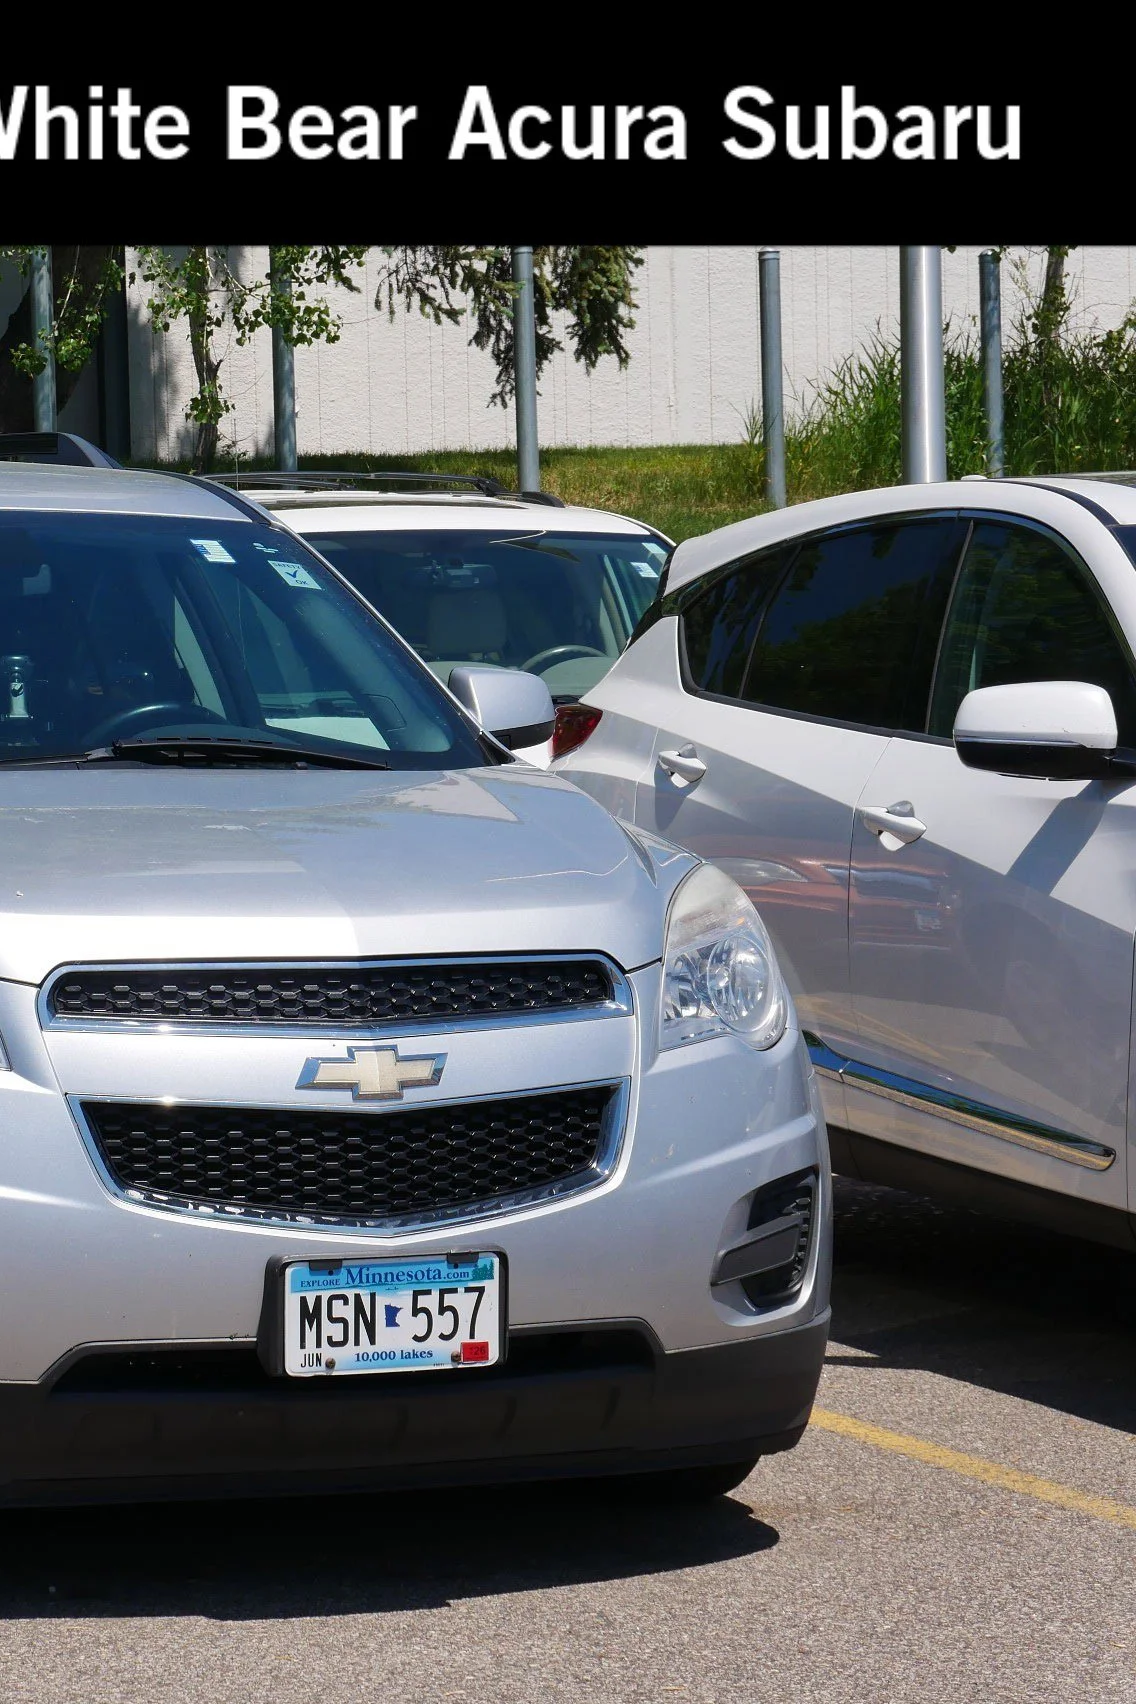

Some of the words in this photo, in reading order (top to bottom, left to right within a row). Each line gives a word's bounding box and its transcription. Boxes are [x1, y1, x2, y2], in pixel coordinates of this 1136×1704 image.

[300, 1278, 341, 1288] EXPLORE
[345, 1267, 470, 1286] Minnesota.com
[299, 1291, 377, 1350] MSN
[411, 1286, 486, 1343] 557
[300, 1353, 322, 1368] JUN
[354, 1350, 397, 1363] 10,000
[400, 1348, 433, 1360] lakes
